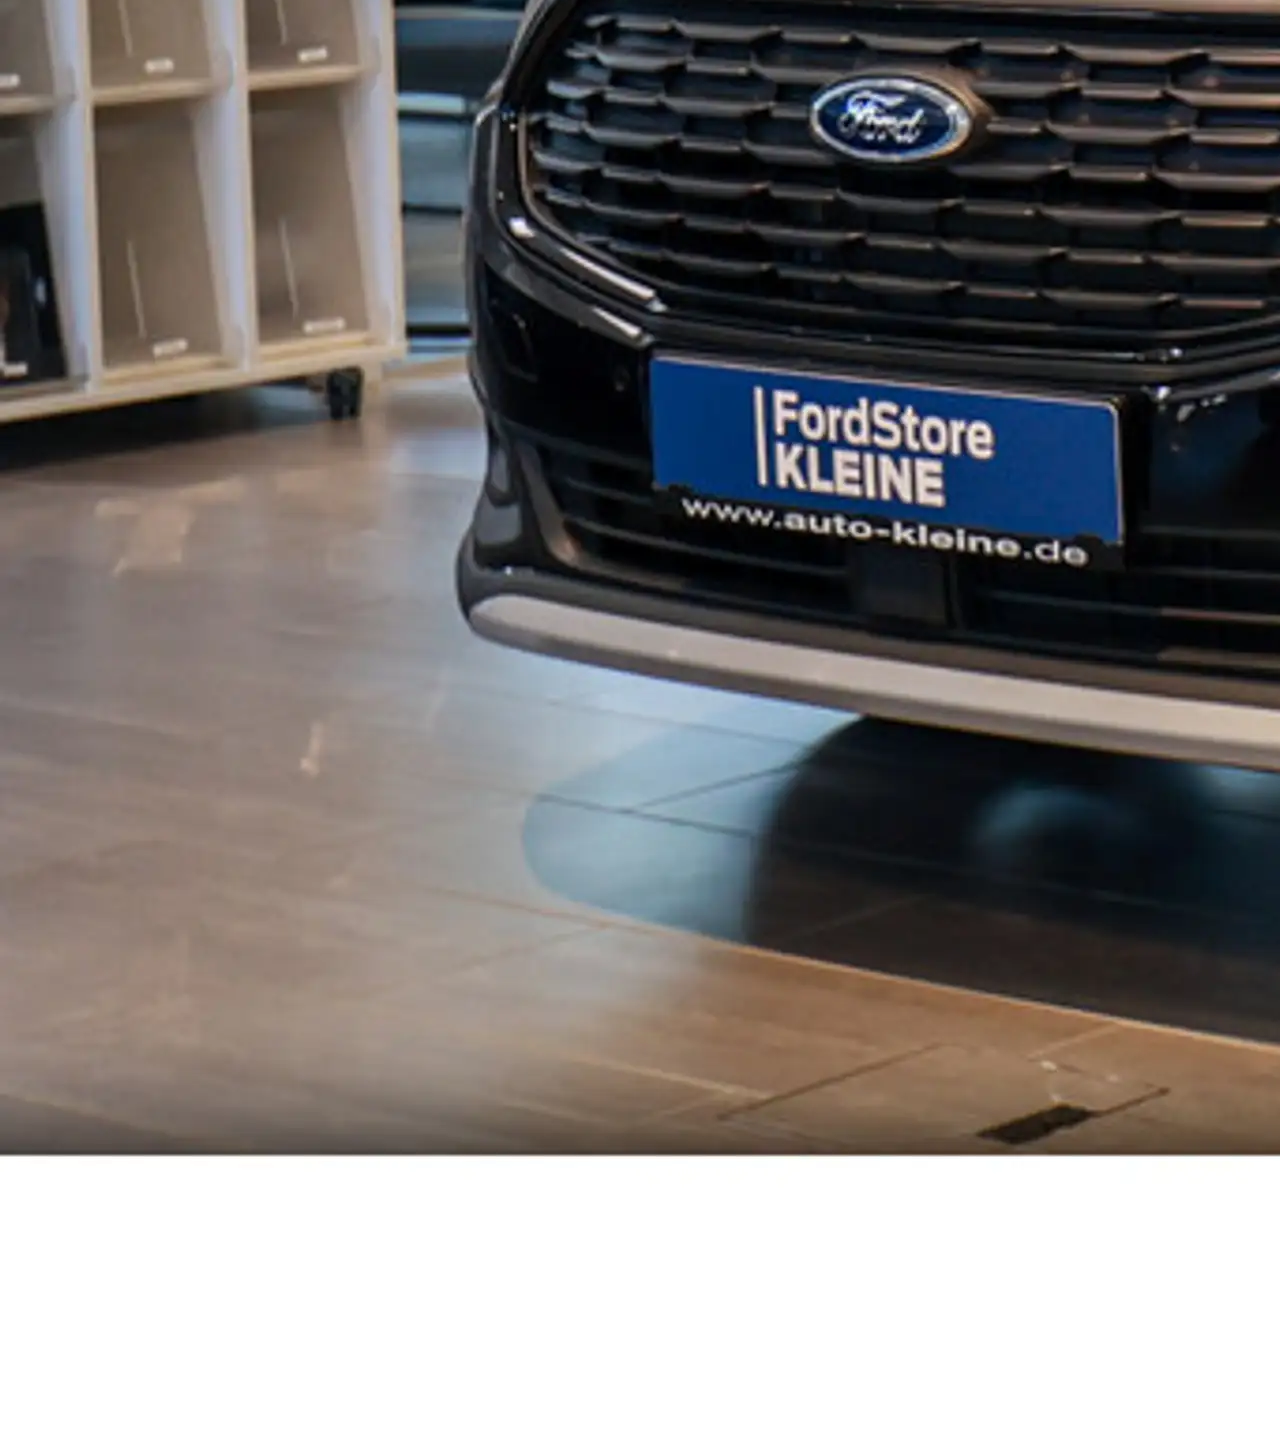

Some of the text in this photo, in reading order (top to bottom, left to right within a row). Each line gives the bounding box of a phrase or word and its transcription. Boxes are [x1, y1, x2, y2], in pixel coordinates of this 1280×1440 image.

[838, 90, 925, 144] Ford
[772, 389, 994, 460] FordStore
[774, 442, 946, 508] KLEINE
[681, 497, 1088, 567] www.auto-kleine.de
